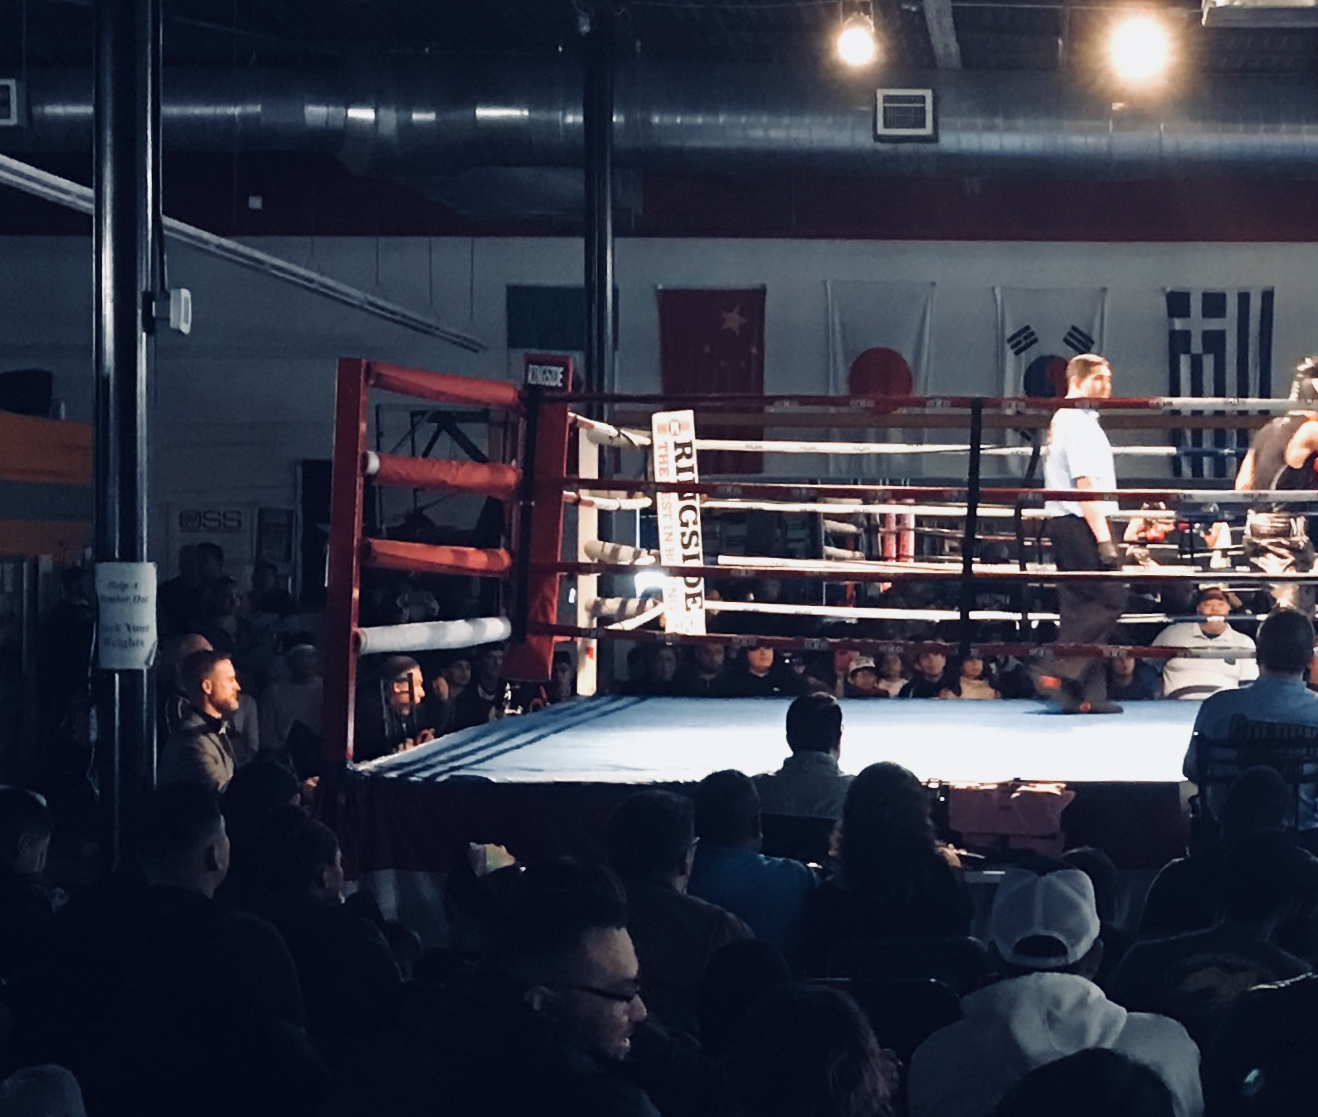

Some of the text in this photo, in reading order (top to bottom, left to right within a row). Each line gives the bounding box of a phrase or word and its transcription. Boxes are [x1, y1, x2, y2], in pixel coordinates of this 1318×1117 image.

[658, 442, 669, 476] THE
[664, 525, 673, 543] IN
[665, 548, 677, 611] BONG
[125, 622, 150, 633] Your
